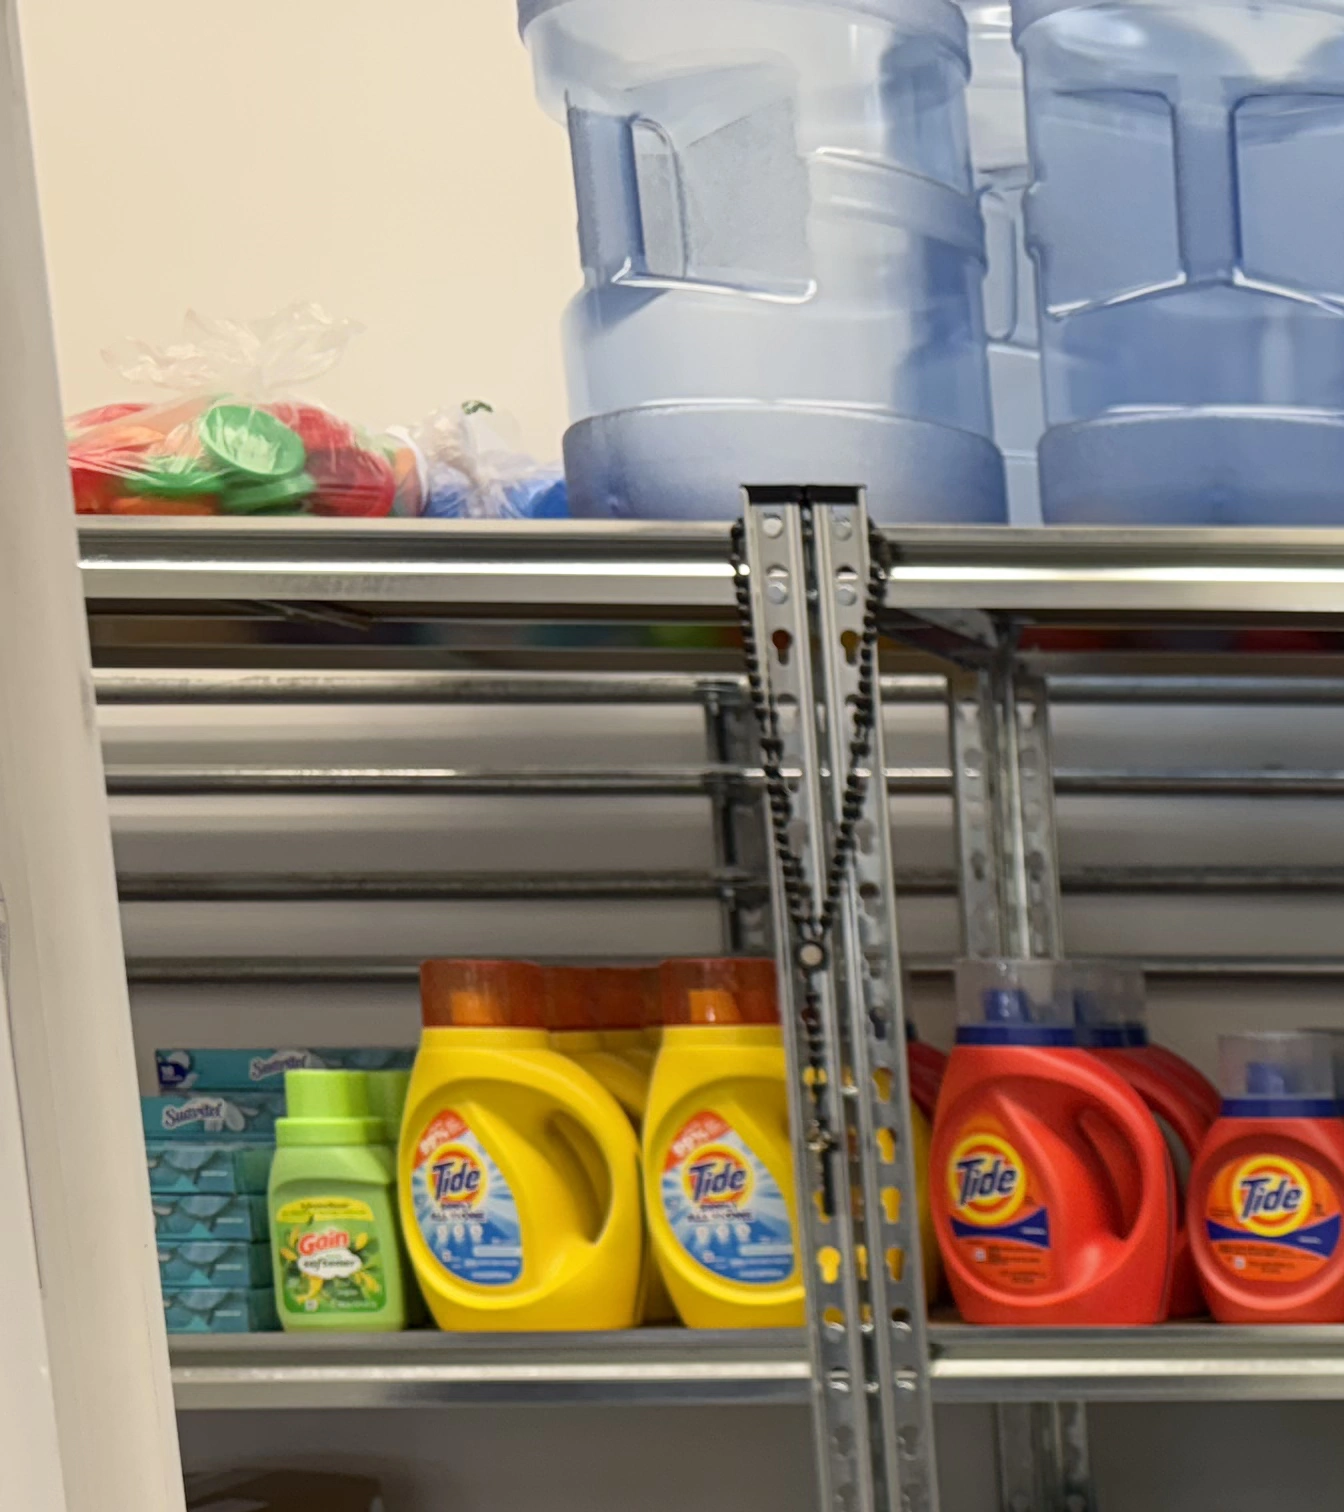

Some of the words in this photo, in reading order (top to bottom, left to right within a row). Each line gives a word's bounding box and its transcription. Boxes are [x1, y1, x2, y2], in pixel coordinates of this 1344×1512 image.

[432, 1161, 481, 1201] Tide
[688, 1162, 747, 1203] Tide
[956, 1157, 1017, 1206] Tide
[1240, 1177, 1303, 1219] Tide
[298, 1229, 350, 1256] Gain
